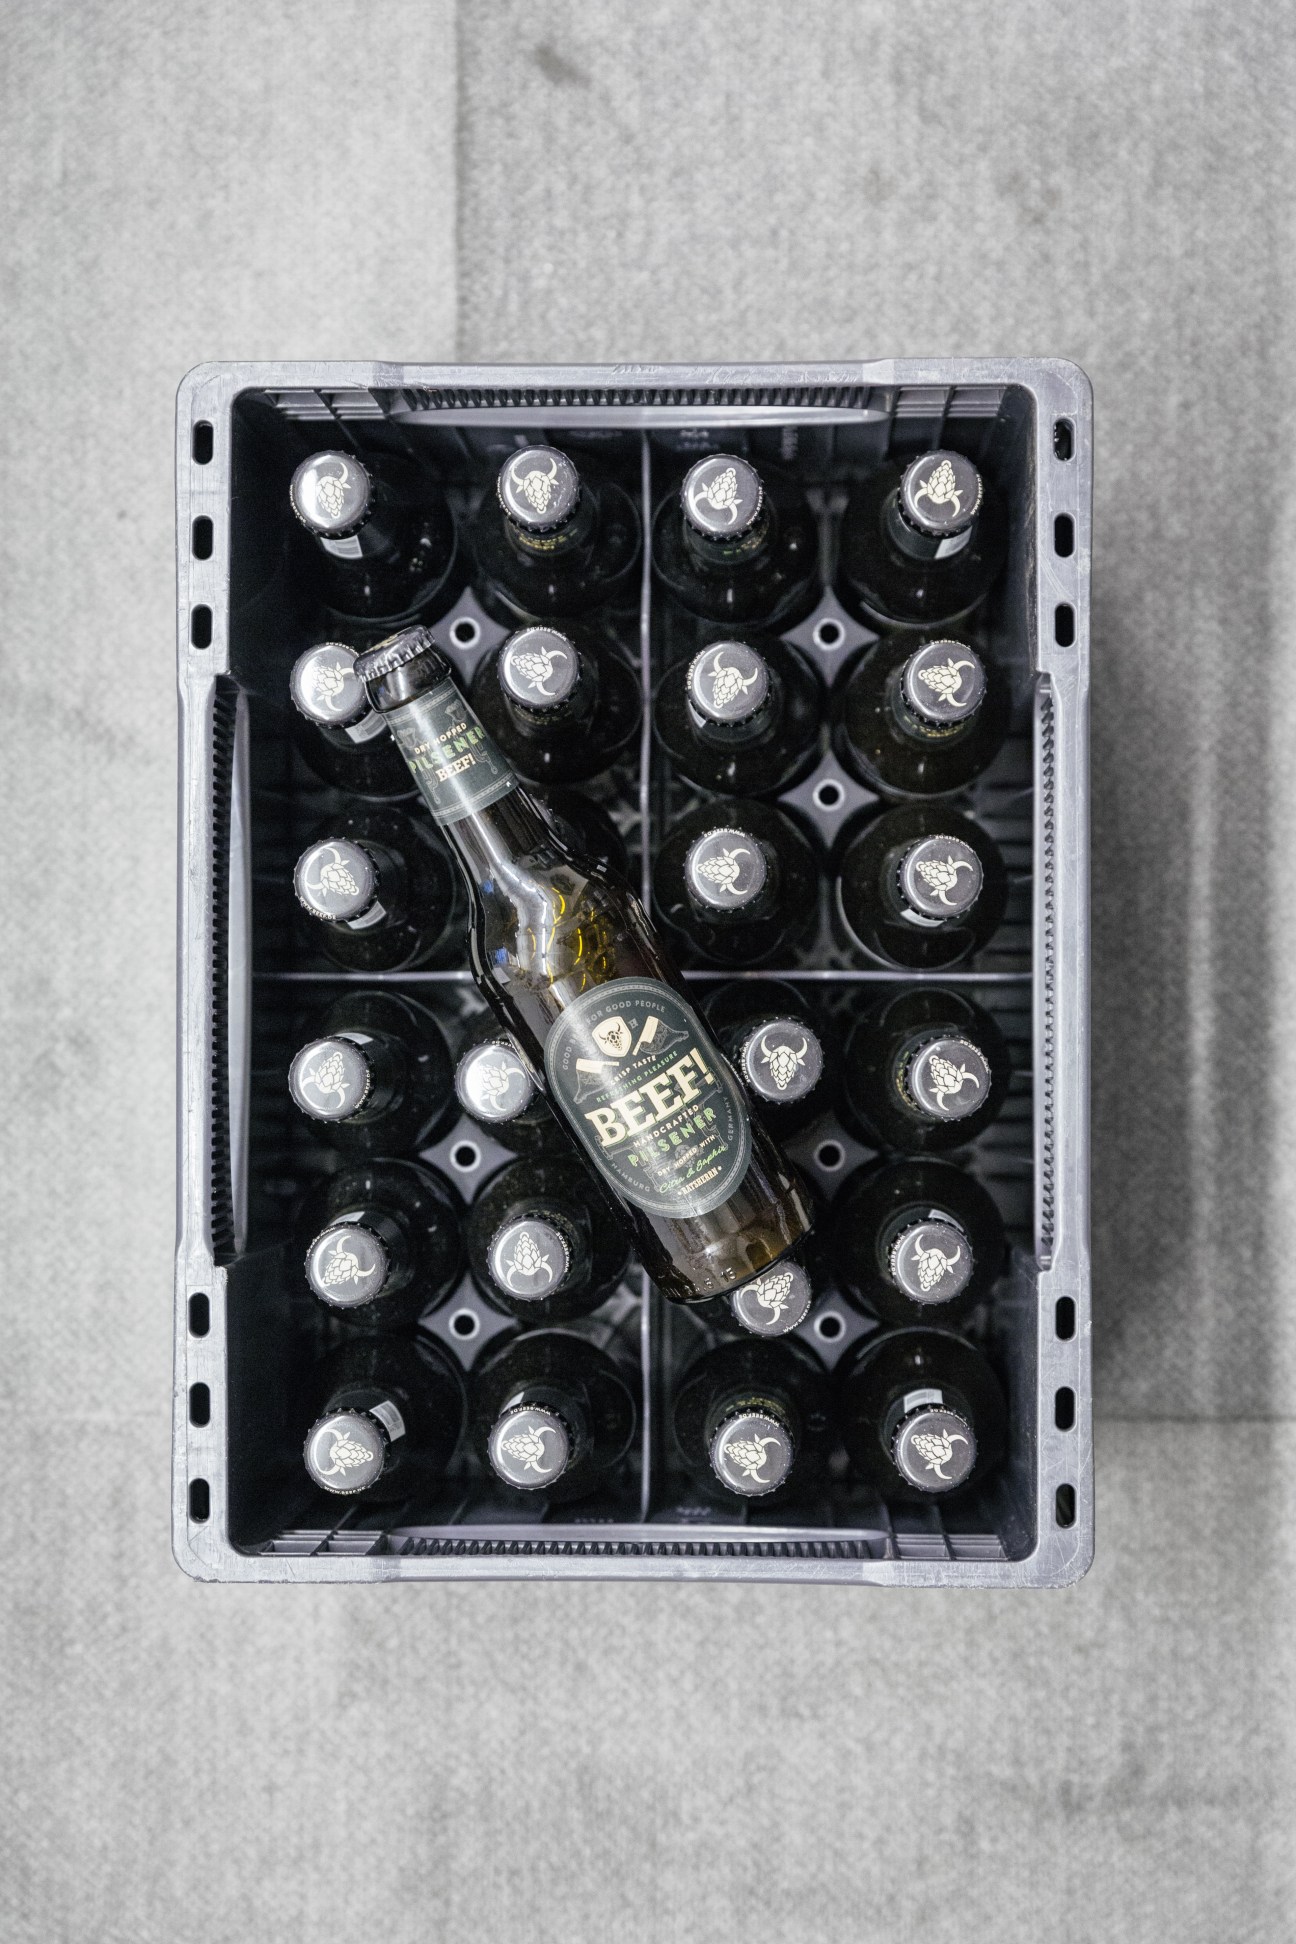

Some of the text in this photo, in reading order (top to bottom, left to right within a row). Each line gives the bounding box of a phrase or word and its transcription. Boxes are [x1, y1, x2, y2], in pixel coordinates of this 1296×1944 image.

[409, 727, 486, 774] PILSENER
[415, 723, 467, 755] DRY HOPPED
[436, 753, 476, 782] BEEF!
[562, 1000, 666, 1070] GOOD FOR GOOD PEOPLE
[610, 1055, 657, 1085] CRISP TASTE
[644, 1051, 679, 1078] PLEASURE
[584, 1048, 714, 1149] BEEF!
[724, 1096, 734, 1141] GERMANY
[628, 1107, 717, 1168] PILSENER
[633, 1104, 700, 1147] HANDCRAFTED
[611, 1162, 651, 1192] HAMBURG
[657, 1134, 716, 1177] DRY HOPPED WITH
[681, 1167, 719, 1195] RATSHERRN
